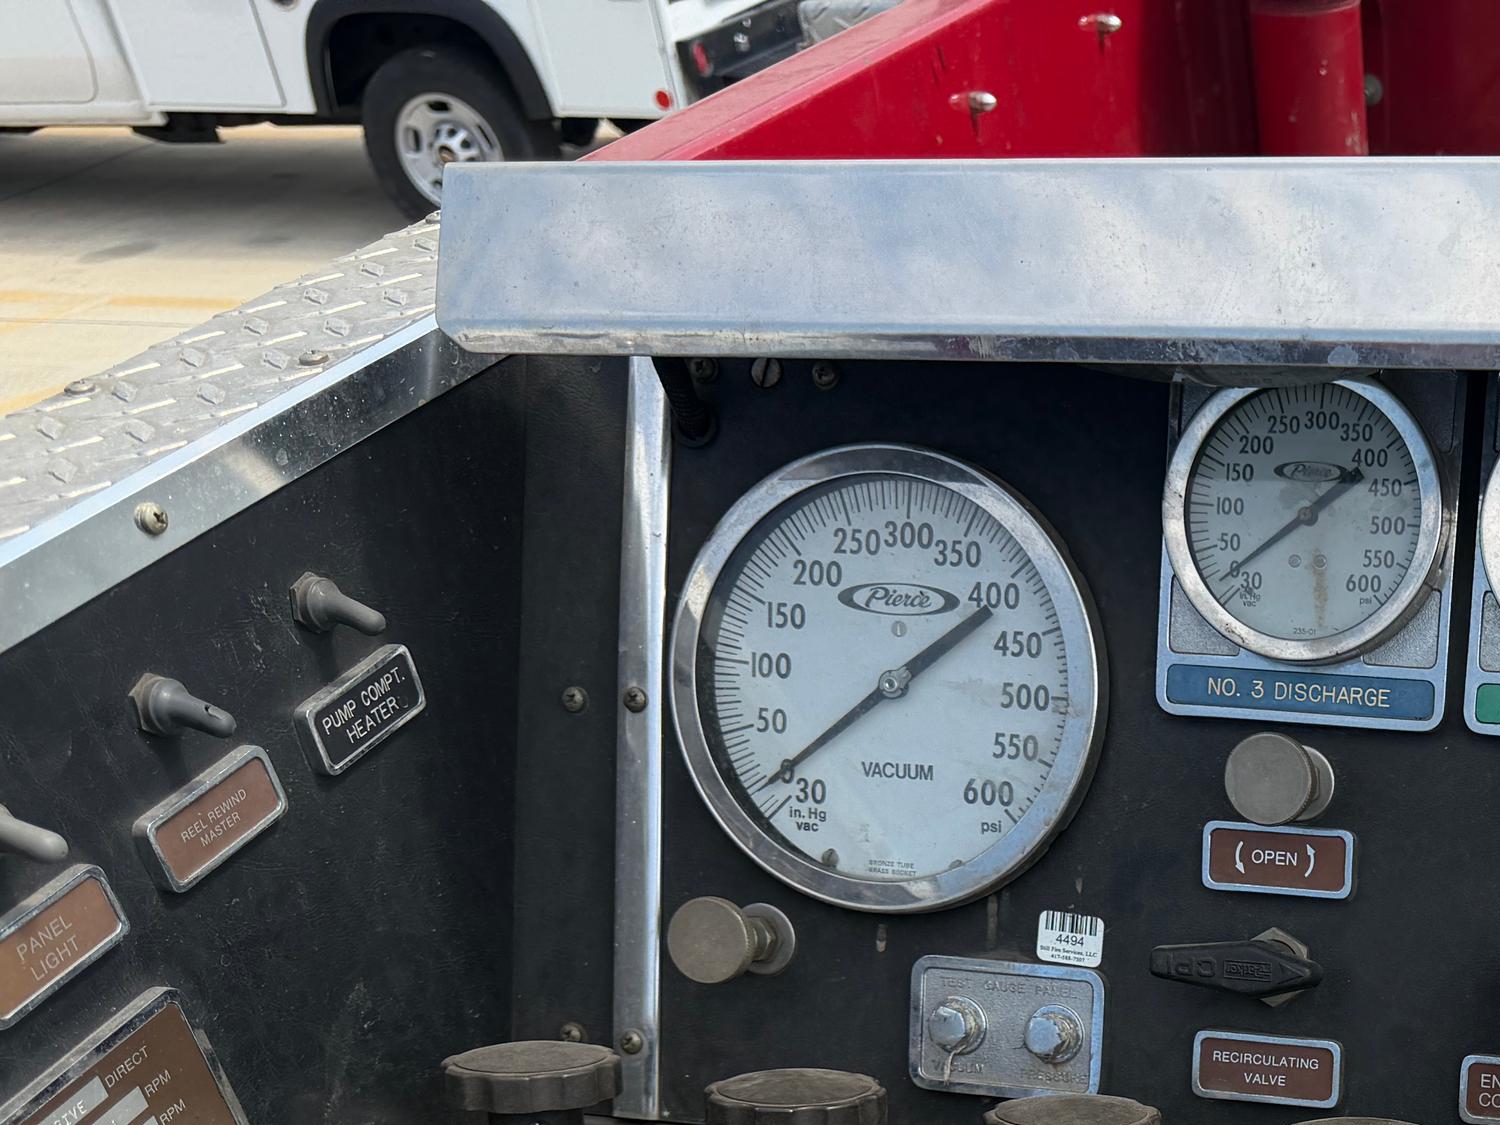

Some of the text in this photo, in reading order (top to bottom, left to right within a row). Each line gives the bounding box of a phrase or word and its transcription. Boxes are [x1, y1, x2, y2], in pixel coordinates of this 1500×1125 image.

[1239, 435, 1274, 456] 200
[833, 527, 881, 556] 250
[884, 521, 934, 549] 300
[933, 539, 982, 568] 350
[793, 559, 843, 587] 200
[967, 582, 1020, 611] 400
[766, 602, 807, 630] 150
[993, 632, 1043, 659] 450
[751, 652, 792, 679] 100
[322, 667, 406, 735] PUMP COMPT.
[1001, 683, 1050, 711] 500
[1207, 677, 1392, 708] NO. 3 DISCHARGE
[346, 696, 400, 744] HEATER
[756, 708, 788, 735] 50
[991, 732, 1039, 761] 550
[861, 761, 934, 782] VACUUM
[796, 778, 828, 804] 30
[963, 779, 1015, 808] 600
[181, 789, 247, 843] REEL REWIND
[200, 812, 241, 847] MASTER
[980, 819, 1003, 835] psi
[1250, 849, 1298, 867] OPEN
[16, 915, 72, 962] PANEL
[1056, 934, 1084, 947] 4494
[31, 935, 80, 981] LIGHT
[104, 1046, 150, 1088] DIRECT
[1213, 1050, 1320, 1071] RECIRCULATING
[144, 1069, 172, 1098] RPM
[1243, 1072, 1287, 1088] VALVE
